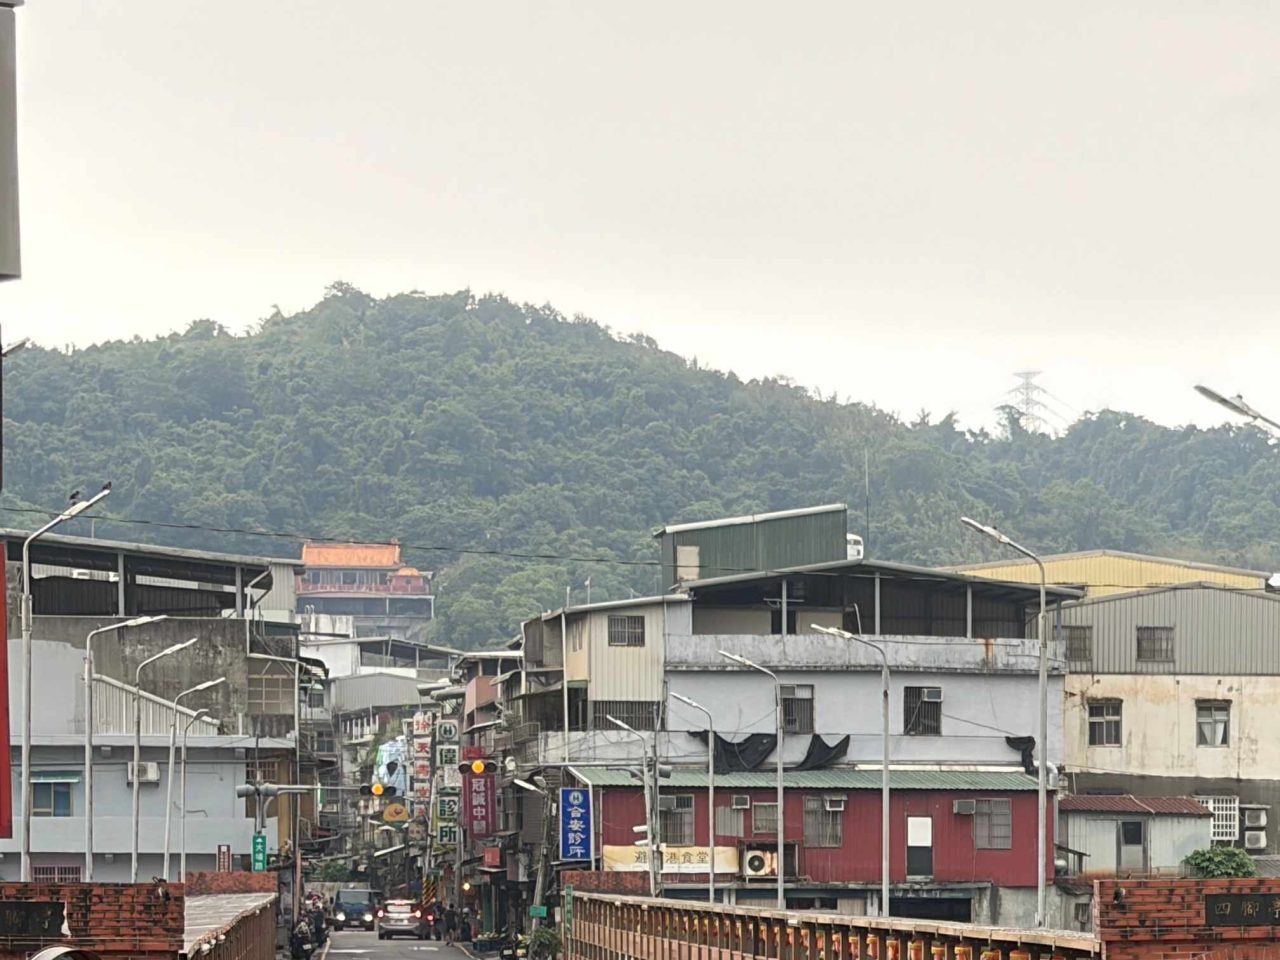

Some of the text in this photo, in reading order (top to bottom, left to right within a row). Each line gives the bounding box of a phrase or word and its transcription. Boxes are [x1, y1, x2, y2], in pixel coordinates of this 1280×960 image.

[439, 747, 458, 842] 偉診所
[634, 850, 709, 865] 避港食堂
